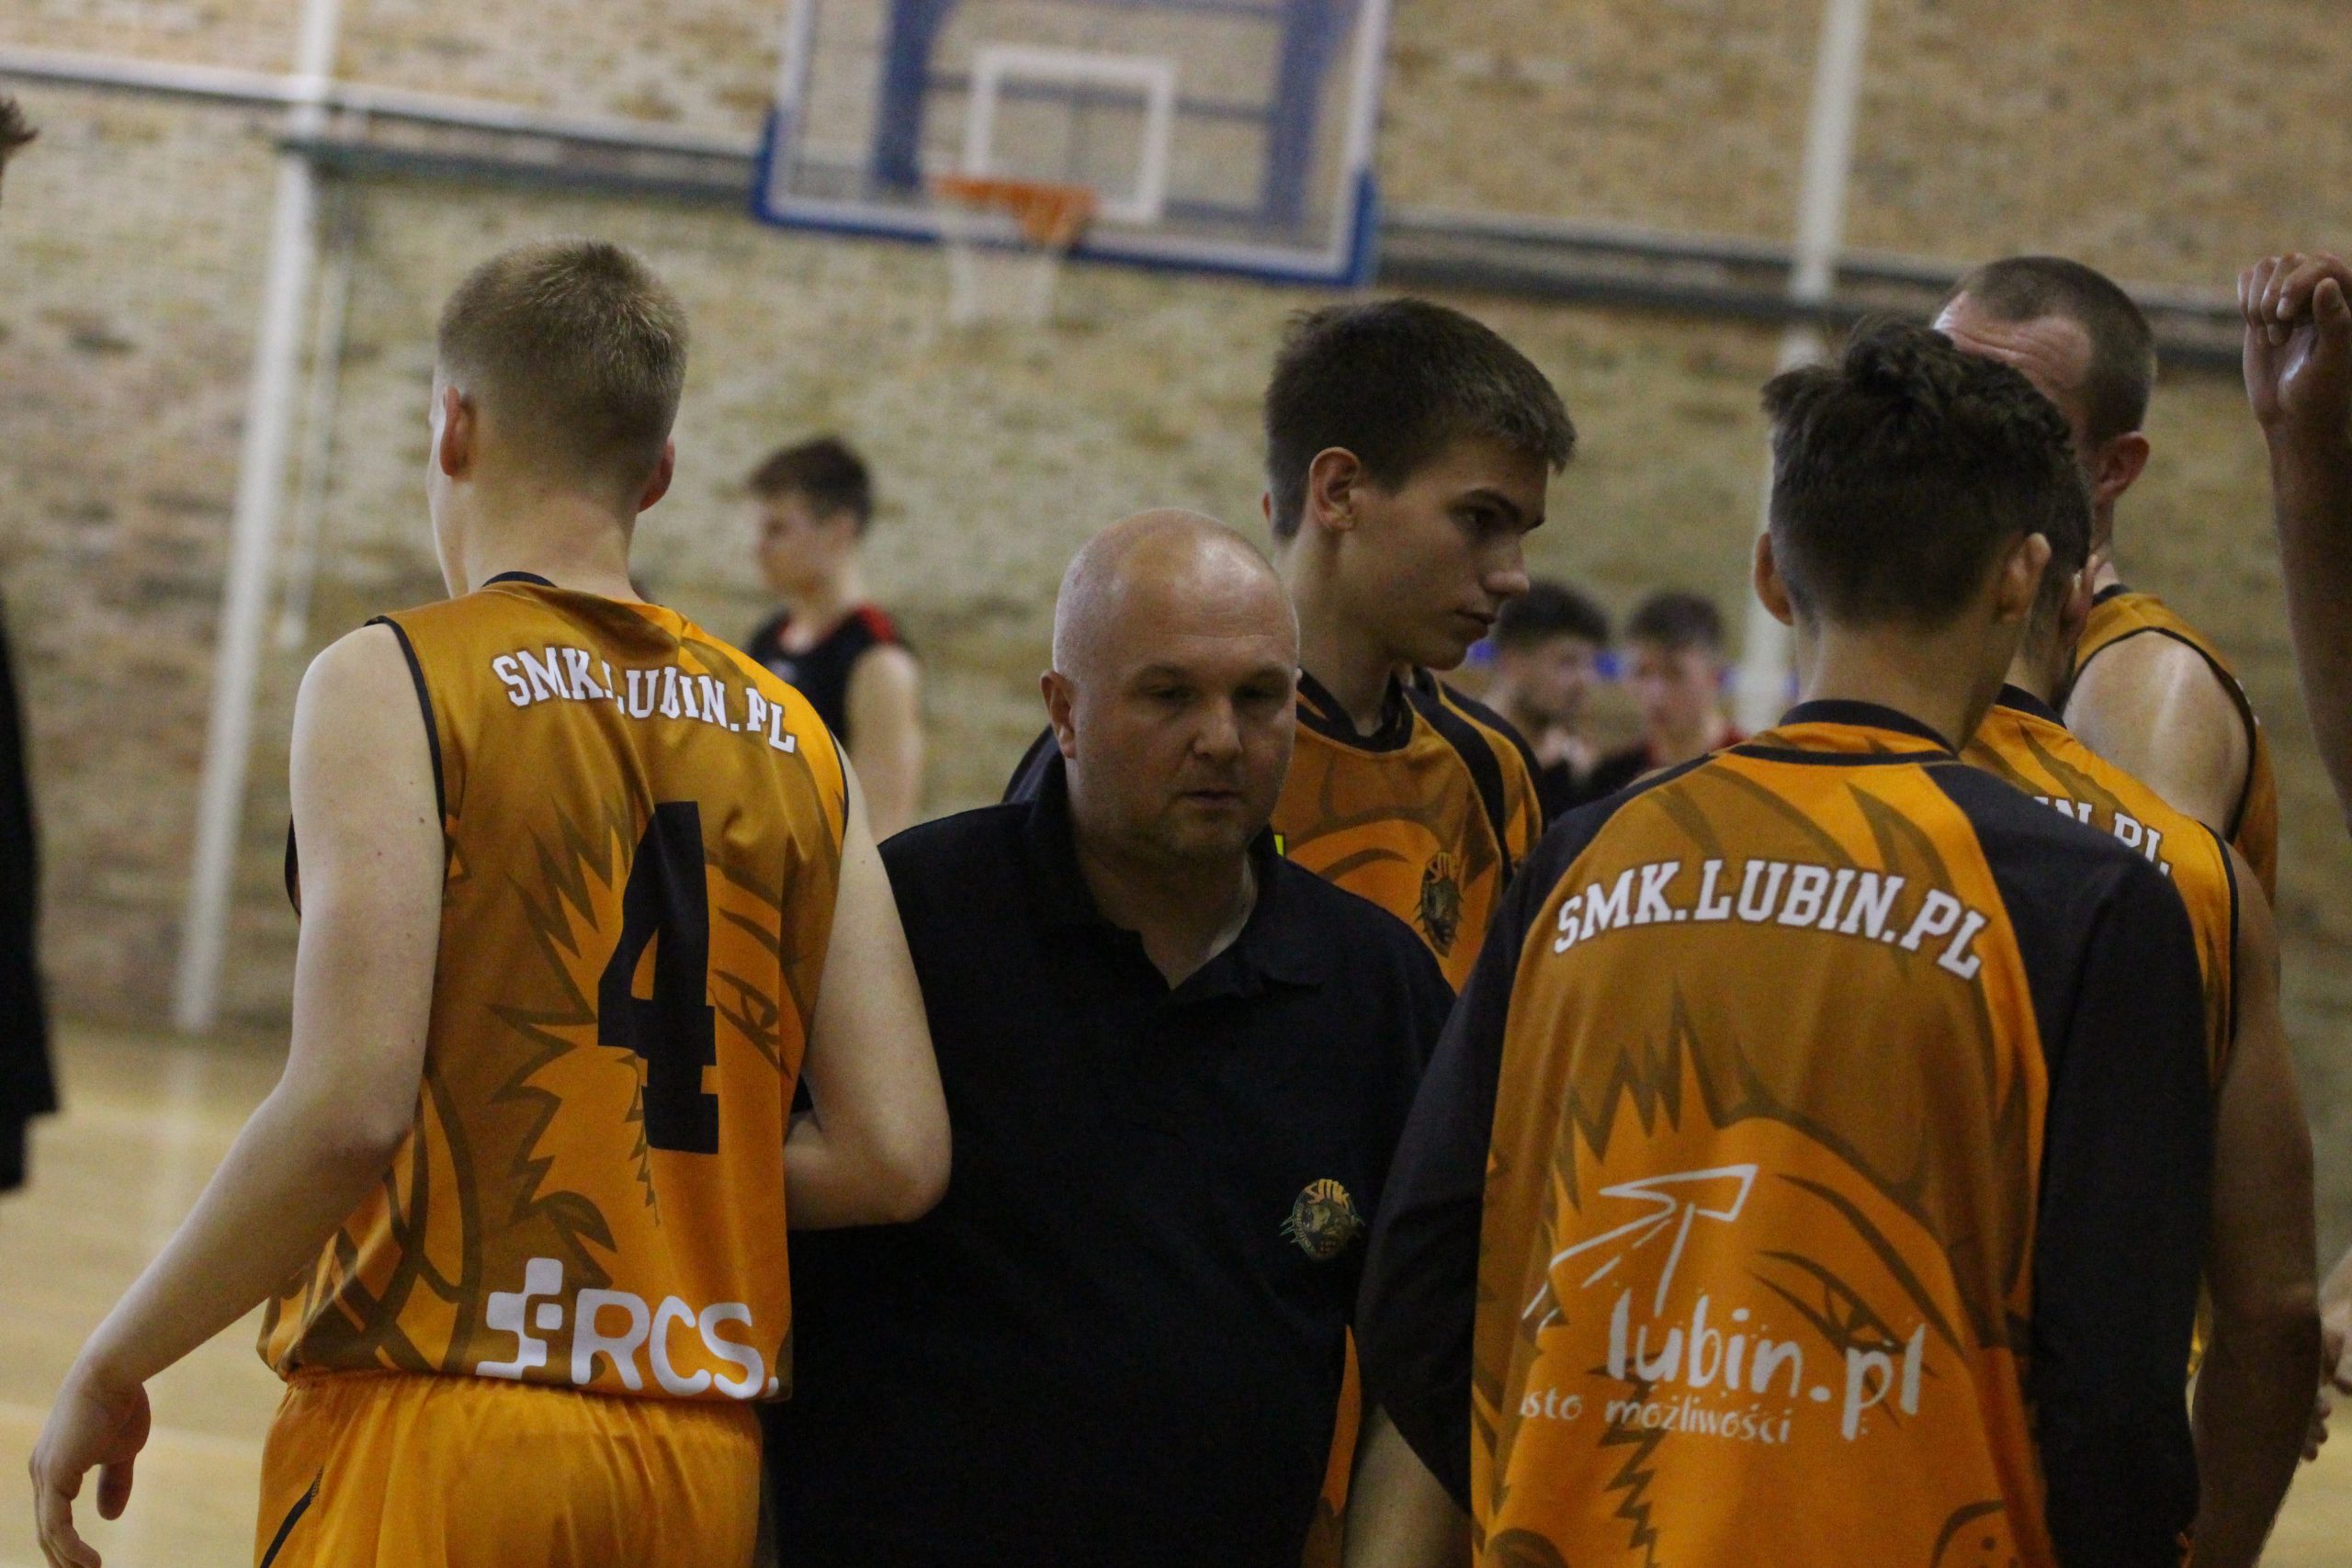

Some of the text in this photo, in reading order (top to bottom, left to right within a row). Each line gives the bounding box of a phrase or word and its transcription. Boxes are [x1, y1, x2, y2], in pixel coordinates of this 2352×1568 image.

[598, 801, 718, 1154] 4
[1555, 859, 1985, 980] SMK.LUBIN.PL
[1604, 1384, 1792, 1443] możliwości
[1607, 1289, 1926, 1440] lubin.pl
